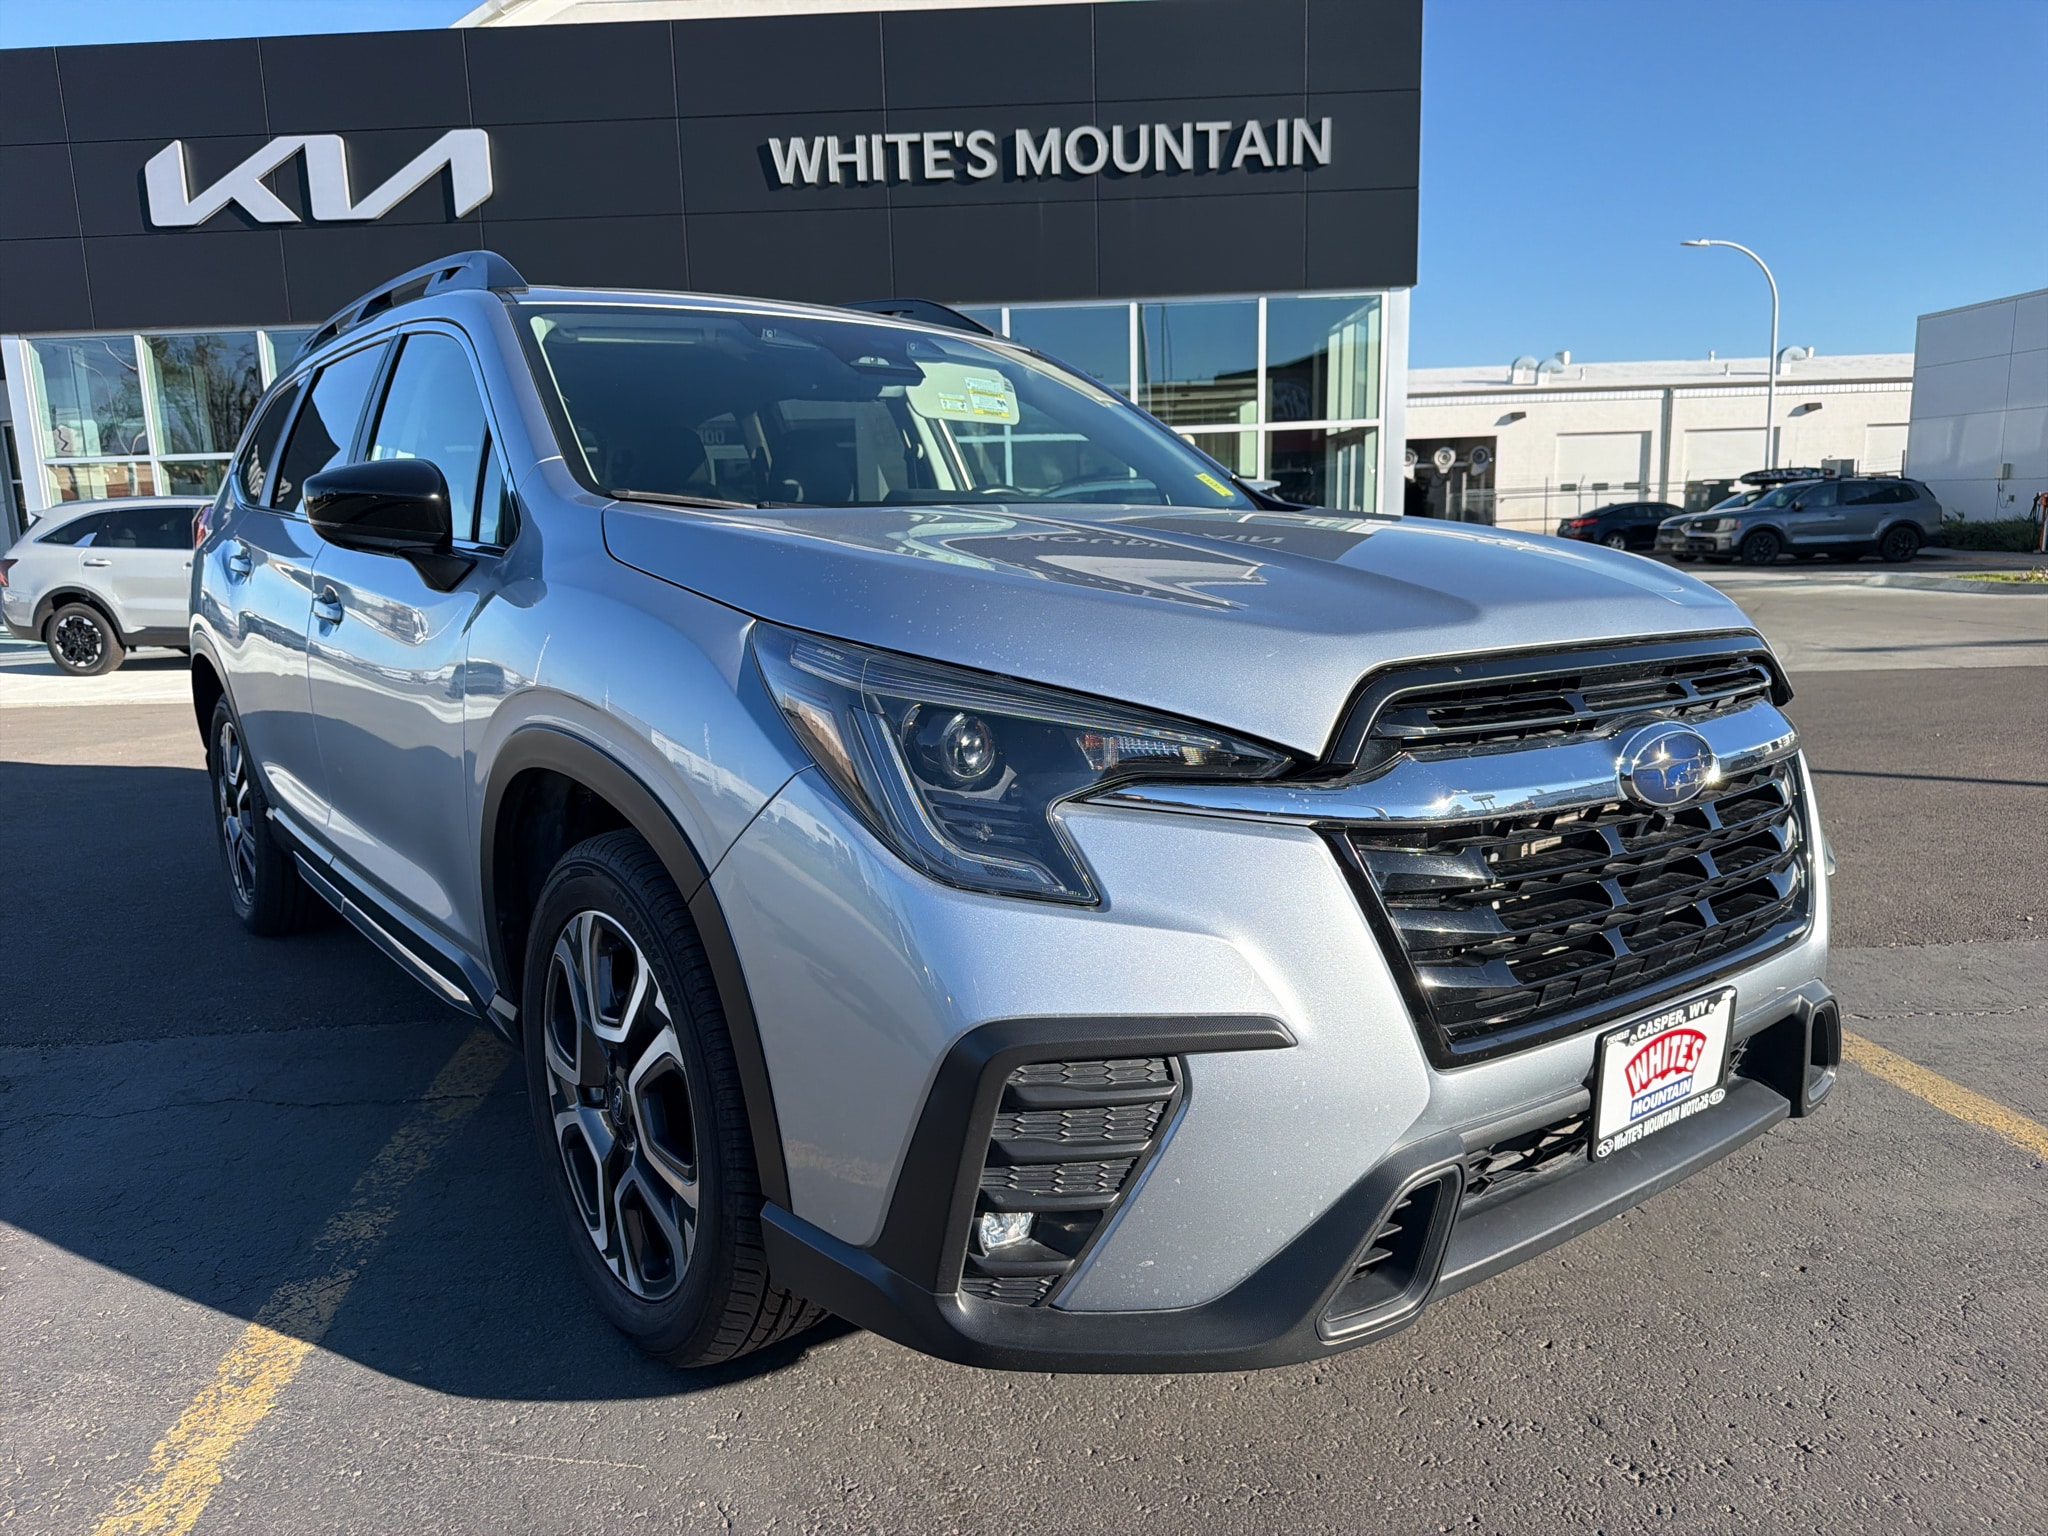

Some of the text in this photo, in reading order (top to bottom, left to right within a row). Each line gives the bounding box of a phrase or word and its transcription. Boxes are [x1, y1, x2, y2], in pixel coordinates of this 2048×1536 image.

[768, 117, 1333, 184] WHITE'S MOUNTAIN
[611, 886, 679, 1008] IRONMAN
[1637, 1000, 1709, 1039] CASPER, WY
[1628, 1033, 1704, 1094] WHITE'S
[1613, 1093, 1709, 1151] WHITE'S MOUNTAIN MOTORS
[1631, 1077, 1692, 1117] MOUNTAIN
